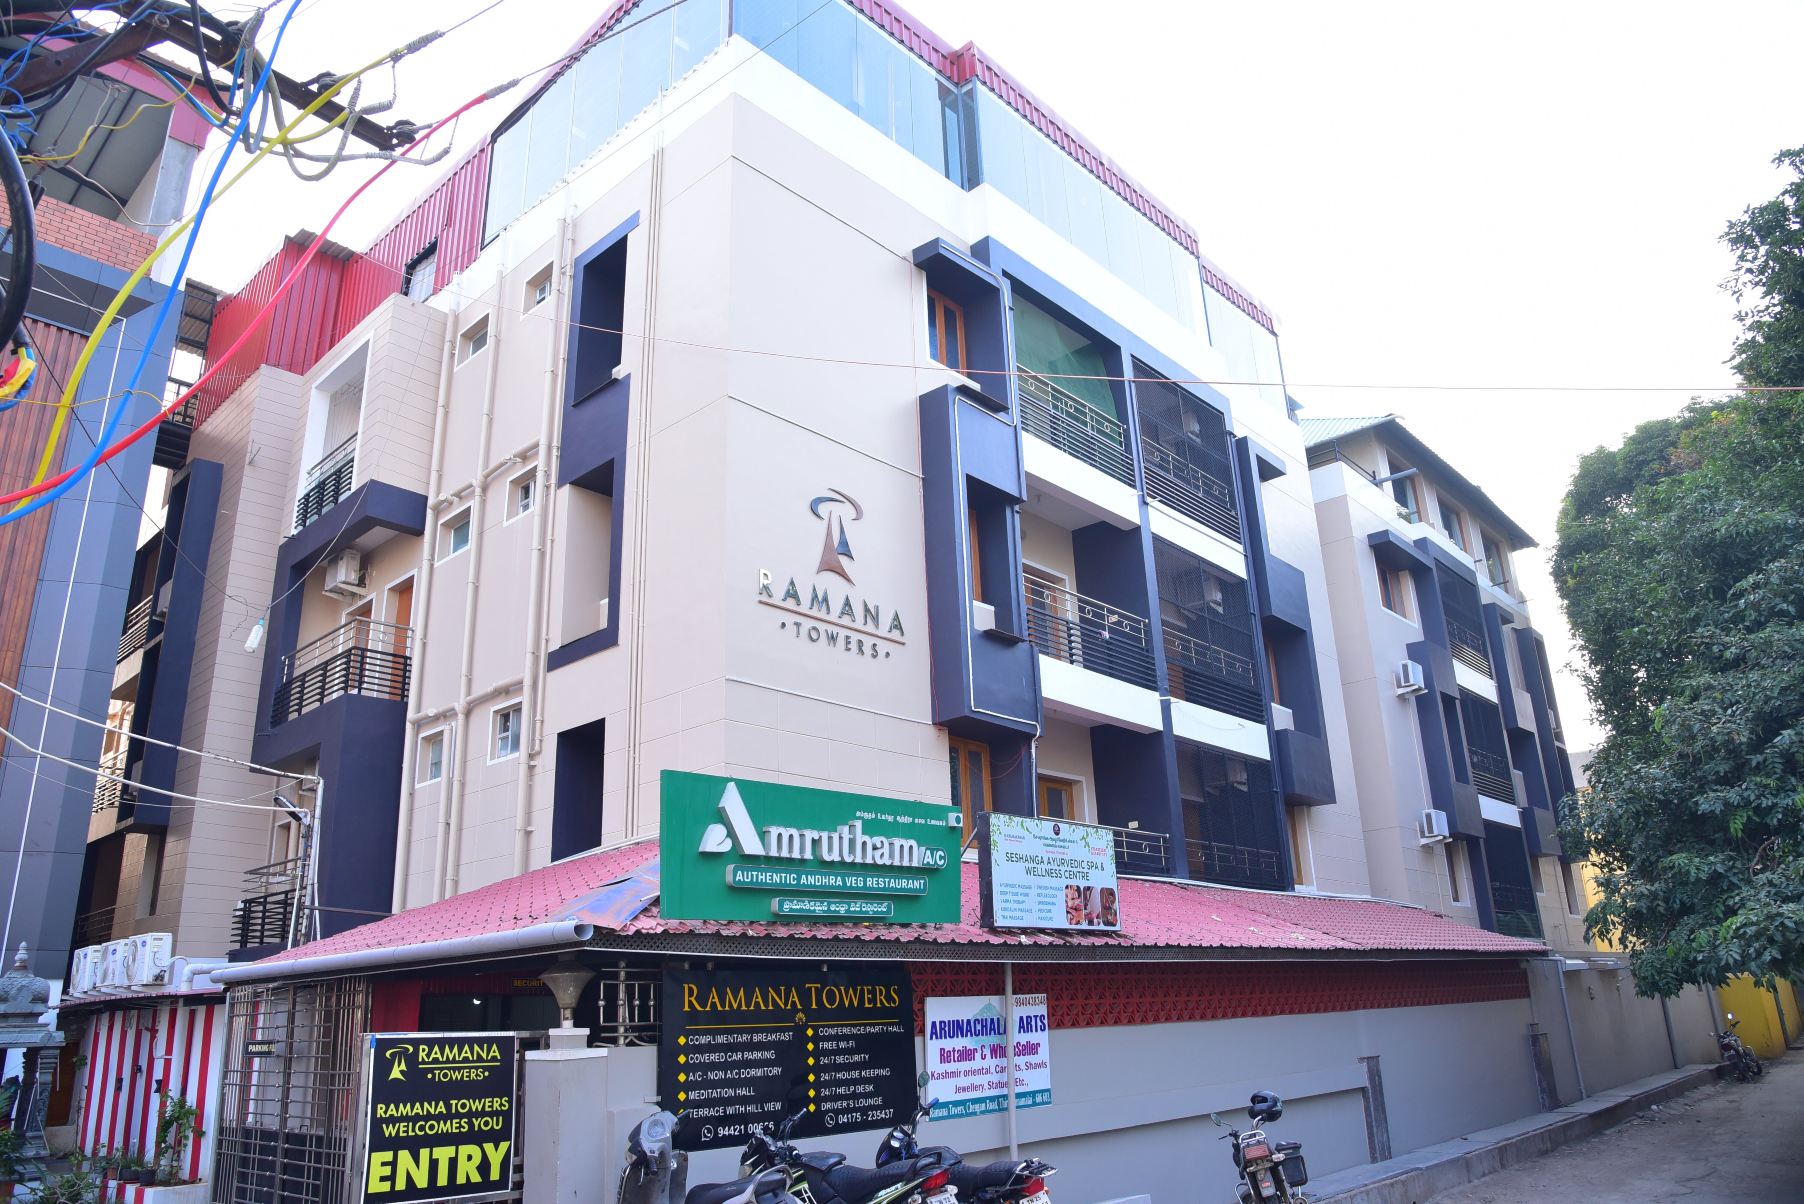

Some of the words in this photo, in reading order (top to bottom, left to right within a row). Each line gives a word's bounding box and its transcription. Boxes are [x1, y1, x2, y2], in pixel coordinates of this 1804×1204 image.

[758, 568, 905, 637] RAMANA
[793, 620, 879, 659] TOWERS
[698, 781, 921, 868] Amrutham
[923, 849, 946, 867] A/C
[1005, 851, 1045, 866] SESHANGA
[1046, 856, 1086, 870] AYURVEDIC
[1086, 860, 1099, 870] SPA
[1100, 864, 1105, 872] &
[735, 869, 798, 886] AUTHENTIC
[800, 872, 843, 888] ANDHRA
[845, 875, 865, 888] VEG
[865, 876, 926, 891] RESTAURANT
[1024, 866, 1063, 879] WELLNESS
[1064, 871, 1090, 881] CENTRE
[682, 983, 802, 1012] RAMANA
[805, 983, 899, 1009] TOWERS
[818, 1025, 887, 1036] CONFERENCE/PARTY
[888, 1024, 904, 1033] HALL
[1018, 1014, 1047, 1034] ARTS
[688, 1034, 751, 1045] COMPLIMENTARY
[752, 1032, 793, 1042] BREAKFAST
[819, 1041, 837, 1050] FREE
[838, 1040, 856, 1049] WI-FI
[418, 1042, 501, 1062] RAMANA
[688, 1053, 726, 1064] COVERED
[727, 1053, 742, 1062] CAR
[743, 1051, 776, 1060] PARKING
[819, 1056, 835, 1065] 24/7
[835, 1054, 870, 1064] SECURITY
[940, 1046, 978, 1064] Retailer
[980, 1044, 986, 1061] &
[989, 1040, 1041, 1060] WhoSeller
[434, 1068, 484, 1082] TOWERS
[688, 1072, 702, 1082] A/C
[708, 1071, 725, 1080] NON
[726, 1069, 739, 1079] A/C
[740, 1067, 782, 1078] DORMITORY
[820, 1072, 835, 1081] 24/7
[836, 1071, 860, 1080] HOUSE
[860, 1068, 891, 1078] KEEPING
[930, 1068, 962, 1081] Kashmir
[994, 1062, 1024, 1075] Carts,
[1025, 1060, 1048, 1071] Shawls
[688, 1089, 735, 1100] MEDITATION
[736, 1087, 756, 1097] HALL
[820, 1088, 835, 1097] 24/7
[836, 1087, 854, 1096] HELP
[855, 1084, 874, 1094] DESK
[376, 1100, 447, 1118] RAMANA
[450, 1097, 509, 1114] TOWERS
[688, 1107, 725, 1119] TERRACE
[726, 1105, 745, 1115] WITH
[746, 1104, 763, 1113] HILL
[764, 1102, 782, 1112] VIEW
[820, 1100, 855, 1111] DRIVER'S
[855, 1097, 883, 1107] LOUNGE
[838, 1114, 862, 1124] 04175
[867, 1109, 894, 1121] 235437
[930, 1108, 948, 1118] Ramana
[382, 1118, 469, 1138] WELCOMES
[472, 1116, 503, 1132] YOU
[718, 1124, 745, 1137] 94421
[367, 1140, 511, 1194] ENTRY
